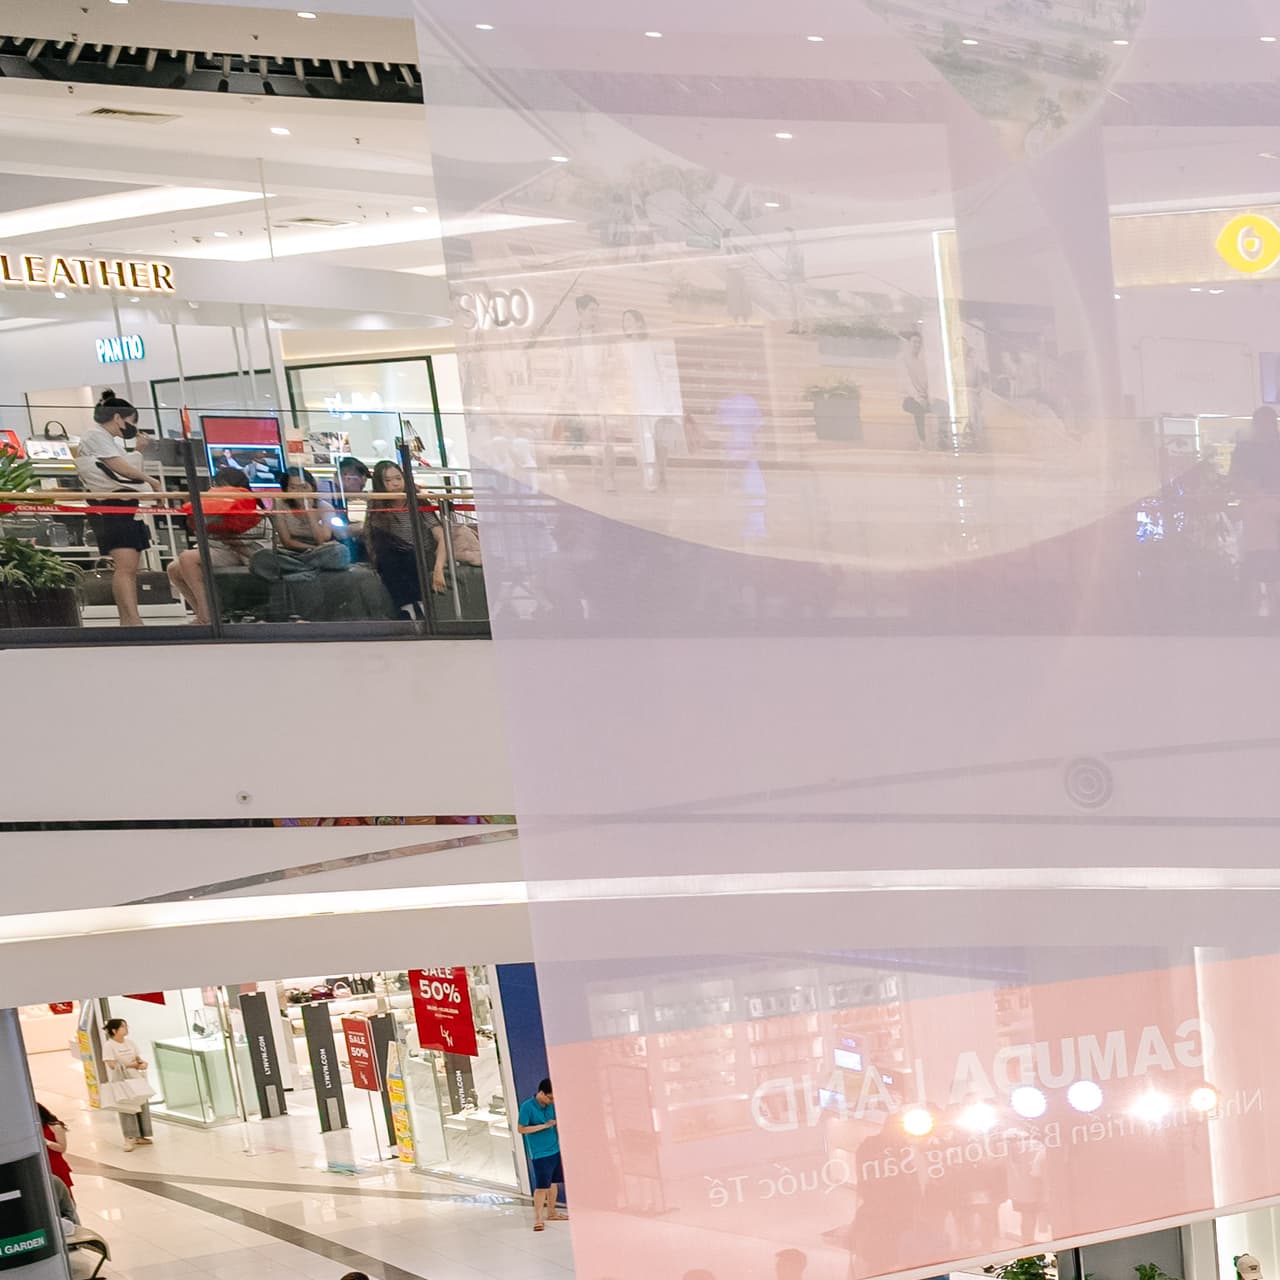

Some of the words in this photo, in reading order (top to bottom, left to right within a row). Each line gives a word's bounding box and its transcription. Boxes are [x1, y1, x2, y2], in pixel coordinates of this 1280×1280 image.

[0, 254, 177, 292] LEATHER
[419, 979, 462, 1004] 50%
[349, 1035, 366, 1046] SALE
[350, 1047, 369, 1059] 50%
[4, 1237, 45, 1255] GARDEN
